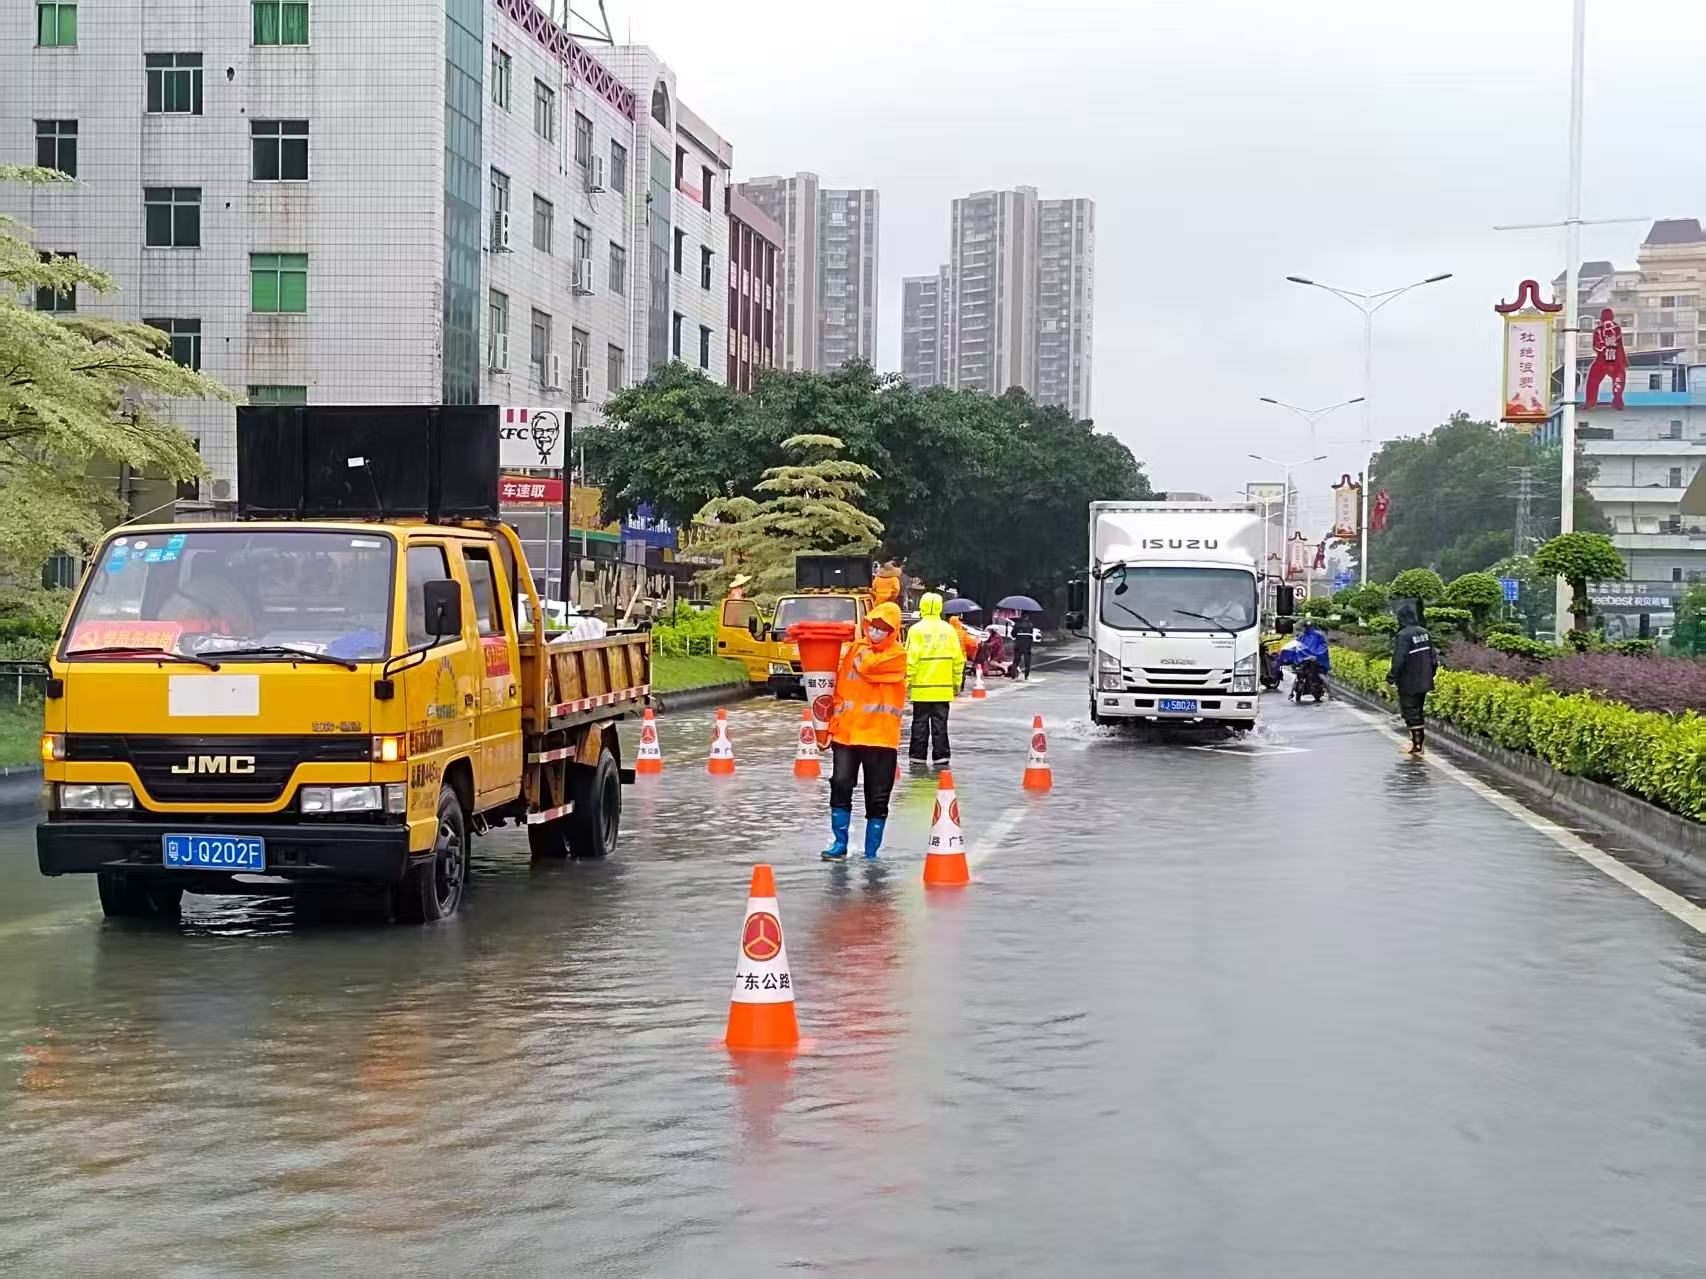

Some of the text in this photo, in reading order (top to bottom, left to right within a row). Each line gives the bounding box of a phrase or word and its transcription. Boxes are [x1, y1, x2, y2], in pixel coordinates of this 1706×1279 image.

[1519, 332, 1536, 389] 杜绝浪费
[499, 428, 529, 440] KFC
[502, 483, 546, 498] 车速取
[1142, 539, 1218, 550] ISUZU
[640, 747, 659, 755] 东公路
[171, 755, 256, 774] JMC
